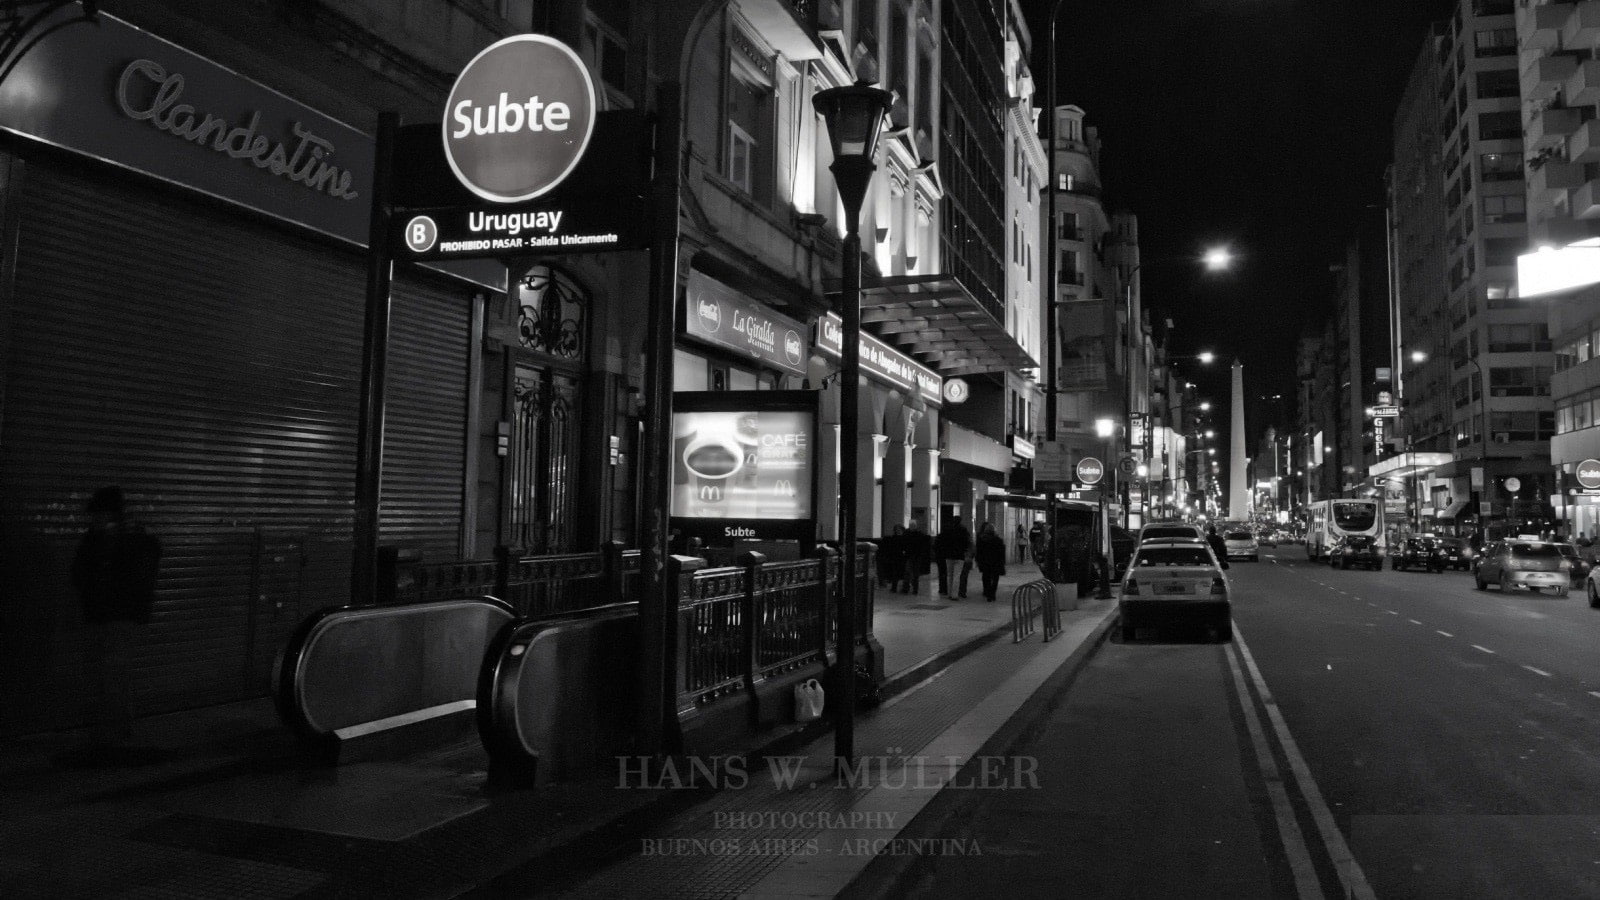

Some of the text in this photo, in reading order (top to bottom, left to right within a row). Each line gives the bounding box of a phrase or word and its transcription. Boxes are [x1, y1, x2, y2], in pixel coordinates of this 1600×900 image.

[453, 93, 570, 139] Subte
[469, 211, 562, 234] Uruguay
[412, 223, 426, 245] B
[440, 240, 491, 252] PROHIBIDO
[492, 237, 523, 249] PASAR
[530, 235, 559, 247] Salida
[561, 233, 618, 246] Unicamente
[732, 309, 775, 346] La Giralda
[761, 431, 807, 447] CAFÉ
[1079, 466, 1100, 475] Subte
[725, 526, 756, 537] Subte
